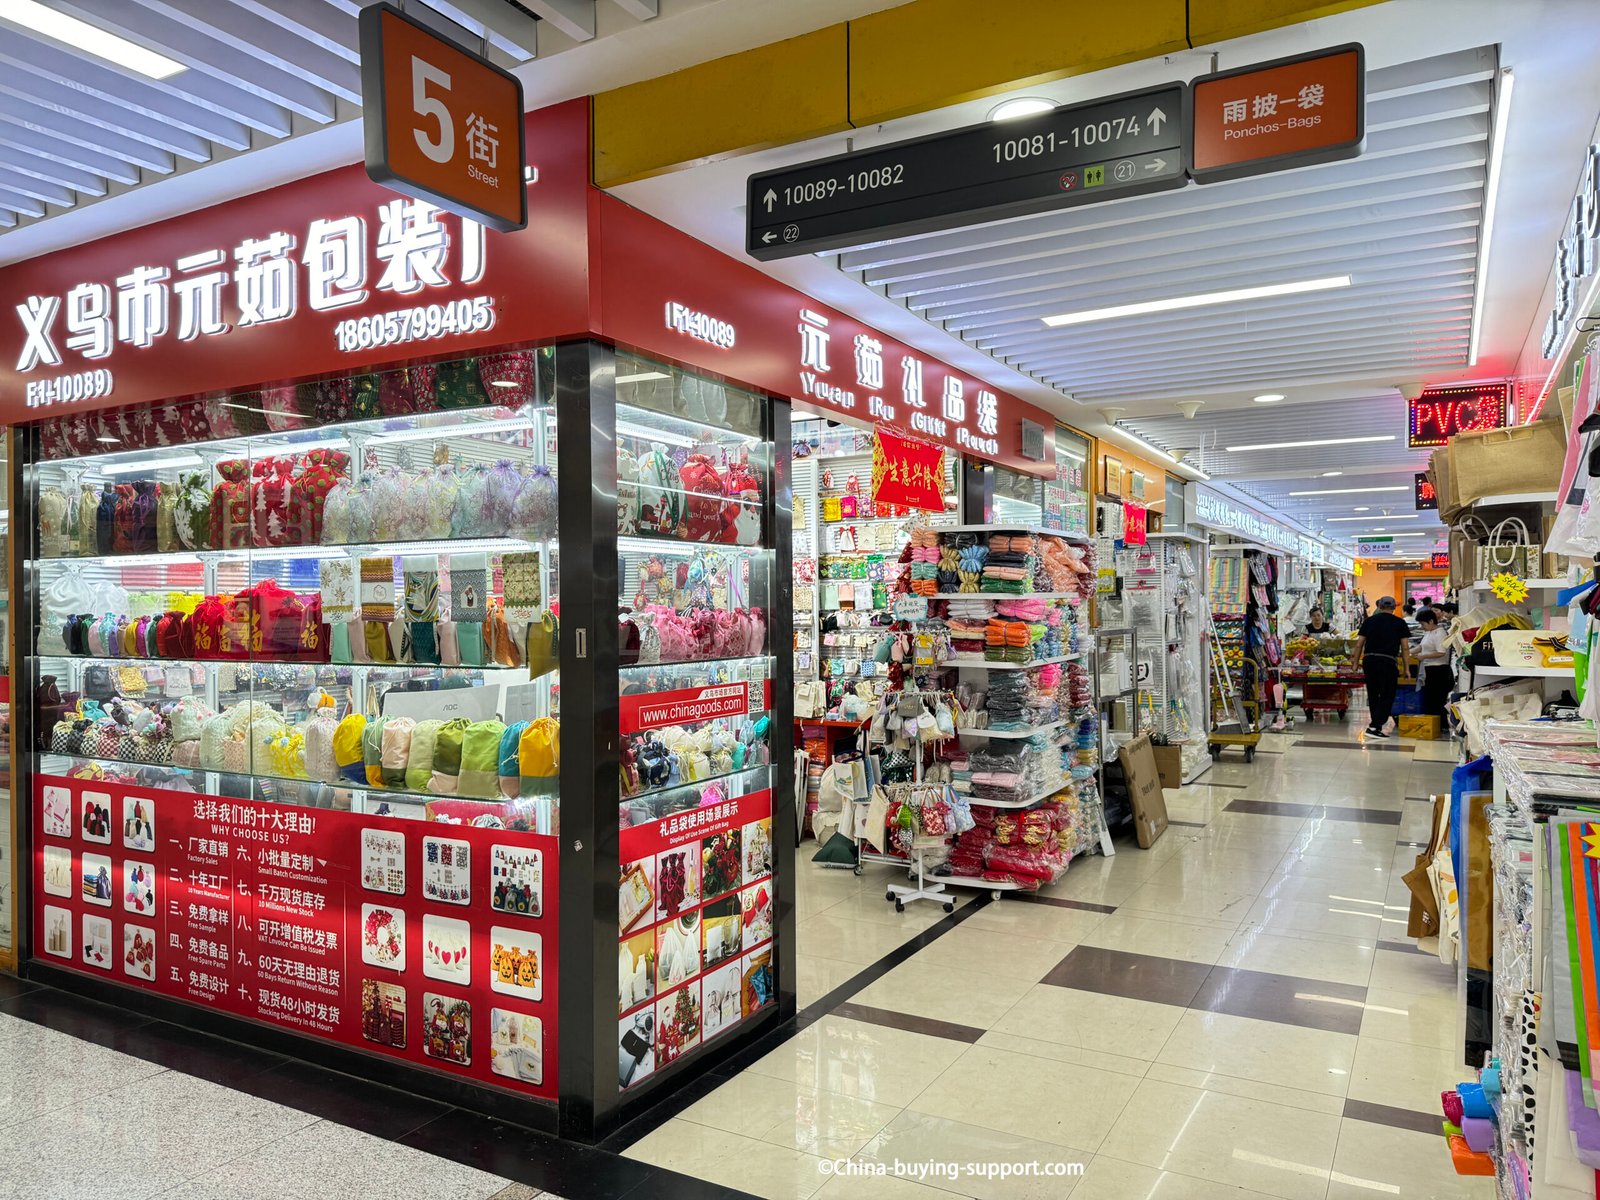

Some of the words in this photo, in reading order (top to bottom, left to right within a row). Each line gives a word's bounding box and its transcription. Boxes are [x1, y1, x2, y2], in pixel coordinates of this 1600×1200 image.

[411, 54, 455, 164] 5
[1223, 111, 1322, 141] Ponchos-Bags
[466, 112, 499, 169] 街
[993, 116, 1141, 164] 10081-10074
[467, 165, 499, 188] Street
[1118, 163, 1133, 178] 21
[783, 164, 905, 207] 10089-10082
[335, 297, 495, 352] 18605799405
[798, 309, 1000, 436] 元茹礼品袋
[800, 372, 855, 407] Yuan
[869, 395, 895, 420] Ru
[911, 412, 946, 437] Gift
[957, 427, 999, 456] Pouch
[888, 454, 935, 491] 生意兴隆
[301, 620, 319, 650] 福
[704, 686, 742, 699] 义乌市场官方网站
[643, 697, 742, 723] www.chinagoods.com
[193, 800, 316, 835] 选择我们的十大理由!
[660, 801, 739, 838] 礼品袋使用场景展示
[211, 824, 230, 837] WHY
[232, 827, 269, 843] CHOOSE
[272, 832, 290, 845] US?
[187, 854, 203, 864] Factory
[203, 856, 218, 866] Sales
[258, 866, 272, 876] Small
[273, 869, 289, 879] Batch
[289, 871, 328, 885] Customization
[265, 902, 286, 913] Millions
[286, 905, 298, 915] New
[298, 907, 314, 918] Stock
[188, 921, 199, 929] Free
[199, 922, 217, 934] Sample
[258, 934, 268, 942] VAT
[289, 941, 299, 950] Can
[188, 954, 199, 963] Free
[199, 956, 212, 967] Spare
[213, 959, 226, 969] Parts
[188, 987, 199, 996] Free
[199, 989, 215, 1001] Design
[257, 970, 264, 978] 60
[278, 975, 296, 986] Return
[296, 979, 318, 991] Without
[318, 985, 339, 996] Reason
[258, 1006, 279, 1020] Stocking
[280, 1010, 302, 1026] Delivery
[308, 1019, 316, 1029] 48
[317, 1020, 333, 1033] Hours
